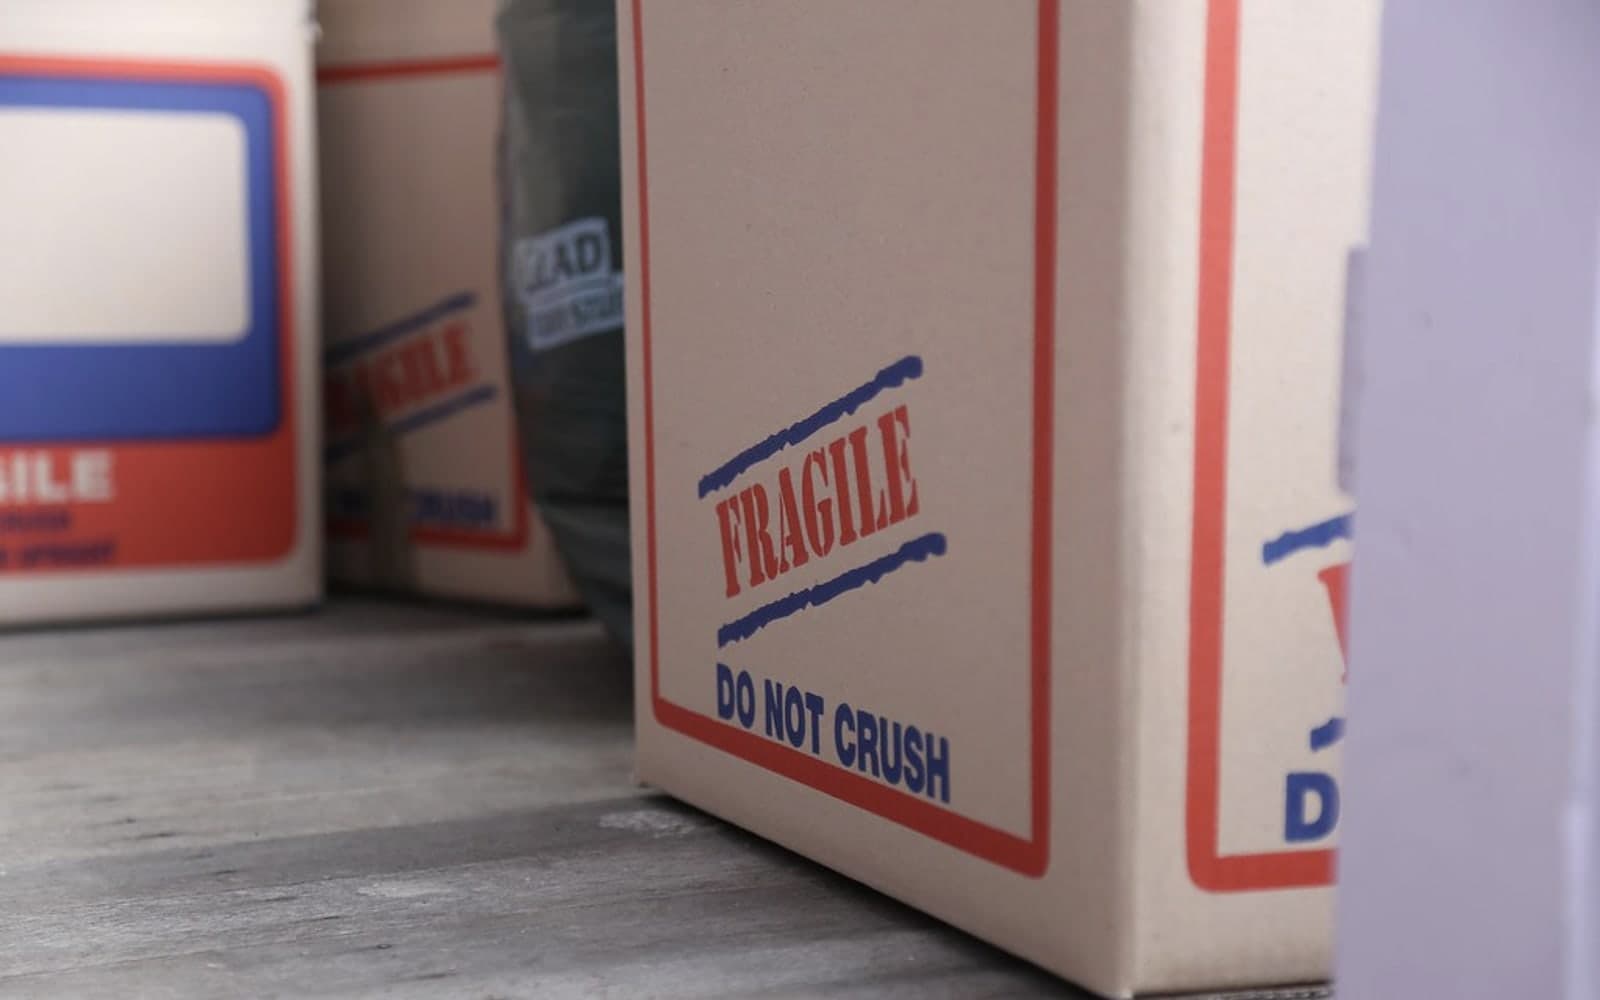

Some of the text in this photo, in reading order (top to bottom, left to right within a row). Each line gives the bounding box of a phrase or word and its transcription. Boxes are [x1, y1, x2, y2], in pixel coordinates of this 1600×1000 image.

[715, 404, 919, 598] FRAGILE
[717, 663, 950, 804] DO NOT CRUSH
